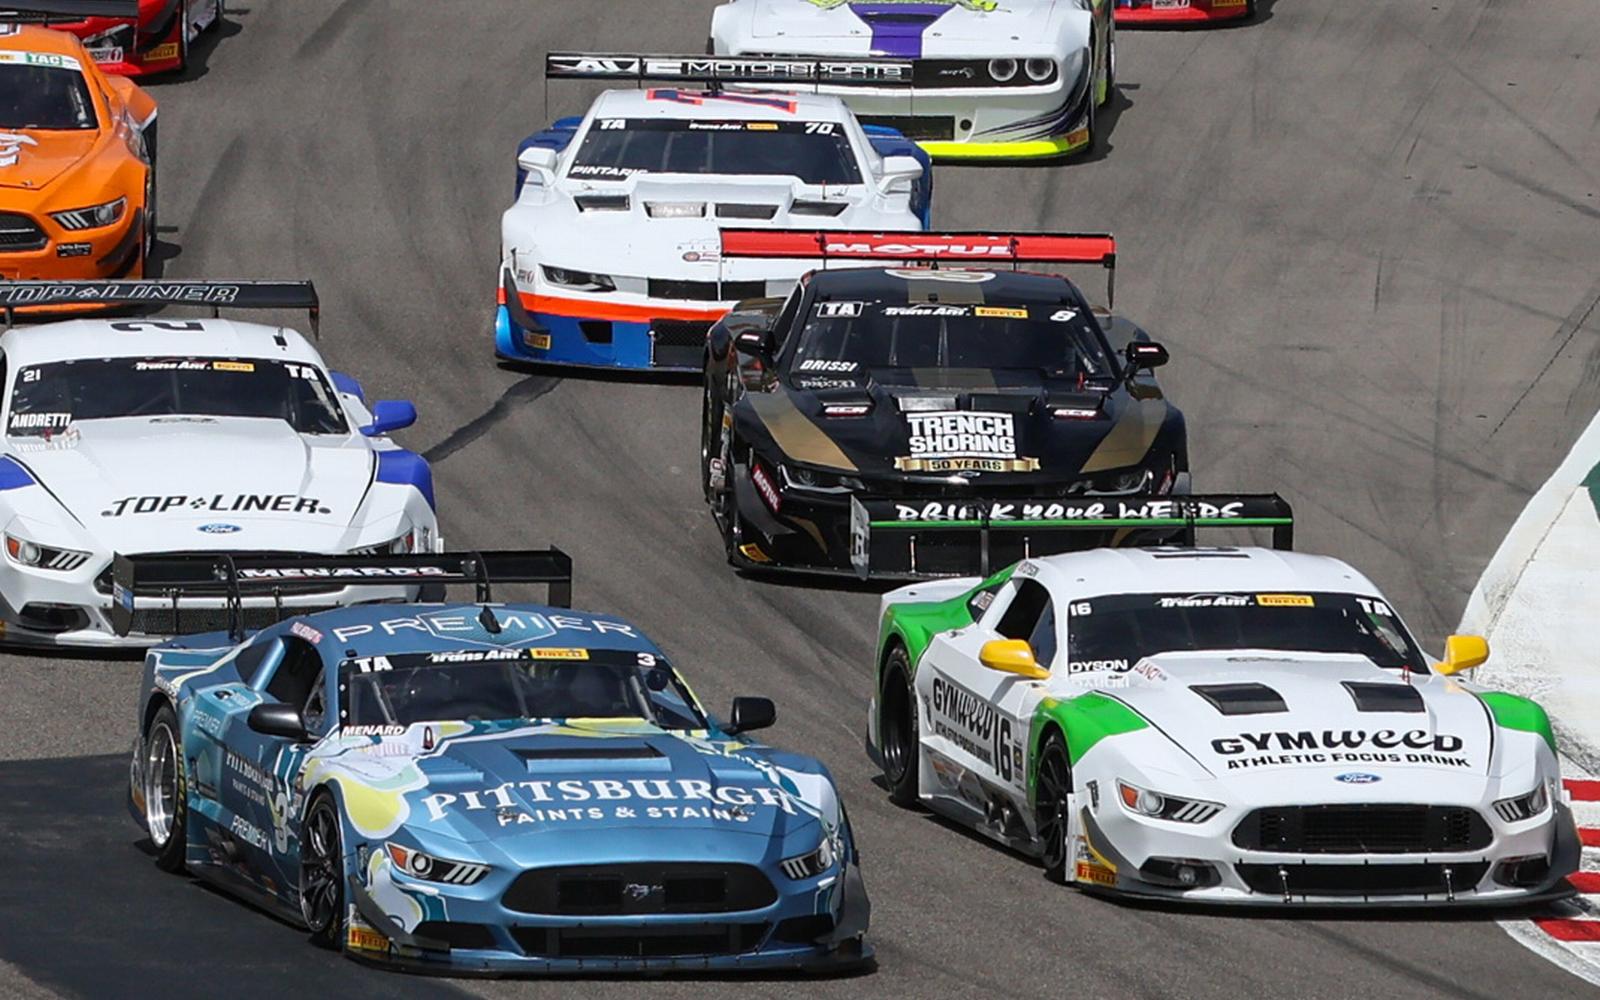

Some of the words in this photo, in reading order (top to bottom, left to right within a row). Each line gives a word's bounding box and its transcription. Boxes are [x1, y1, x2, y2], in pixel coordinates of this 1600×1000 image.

[600, 119, 626, 130] TA
[805, 122, 834, 135] 70
[825, 243, 1013, 255] MOTUL
[100, 285, 239, 302] LINER
[826, 303, 855, 316] TA
[1050, 310, 1077, 322] 8
[284, 364, 319, 381] TA
[799, 360, 858, 371] DRISSI
[22, 369, 41, 382] 21
[10, 413, 73, 429] ANDRETTI
[907, 416, 1014, 436] TRENCH
[909, 434, 1016, 454] SHORING
[931, 460, 951, 470] 50
[954, 460, 1003, 471] YEARS
[753, 469, 779, 513] MOTUL
[112, 496, 188, 517] TOP
[209, 494, 320, 514] LINER
[1118, 501, 1245, 519] WEDS
[1069, 602, 1092, 616] 16
[1355, 598, 1393, 616] TA
[333, 614, 638, 643] PREMIER
[354, 656, 393, 673] TA
[637, 653, 657, 667] 3
[1069, 660, 1129, 674] DYSON
[341, 724, 405, 737] MENARD
[993, 713, 1012, 783] 16
[1227, 754, 1326, 769] ATHLETIC
[1333, 752, 1401, 763] FOCUS
[1407, 754, 1472, 768] DRINK
[421, 779, 799, 822] PITTSBURGH
[498, 807, 604, 827] PAINTS
[615, 806, 637, 818] &
[647, 806, 749, 823] STAINS
